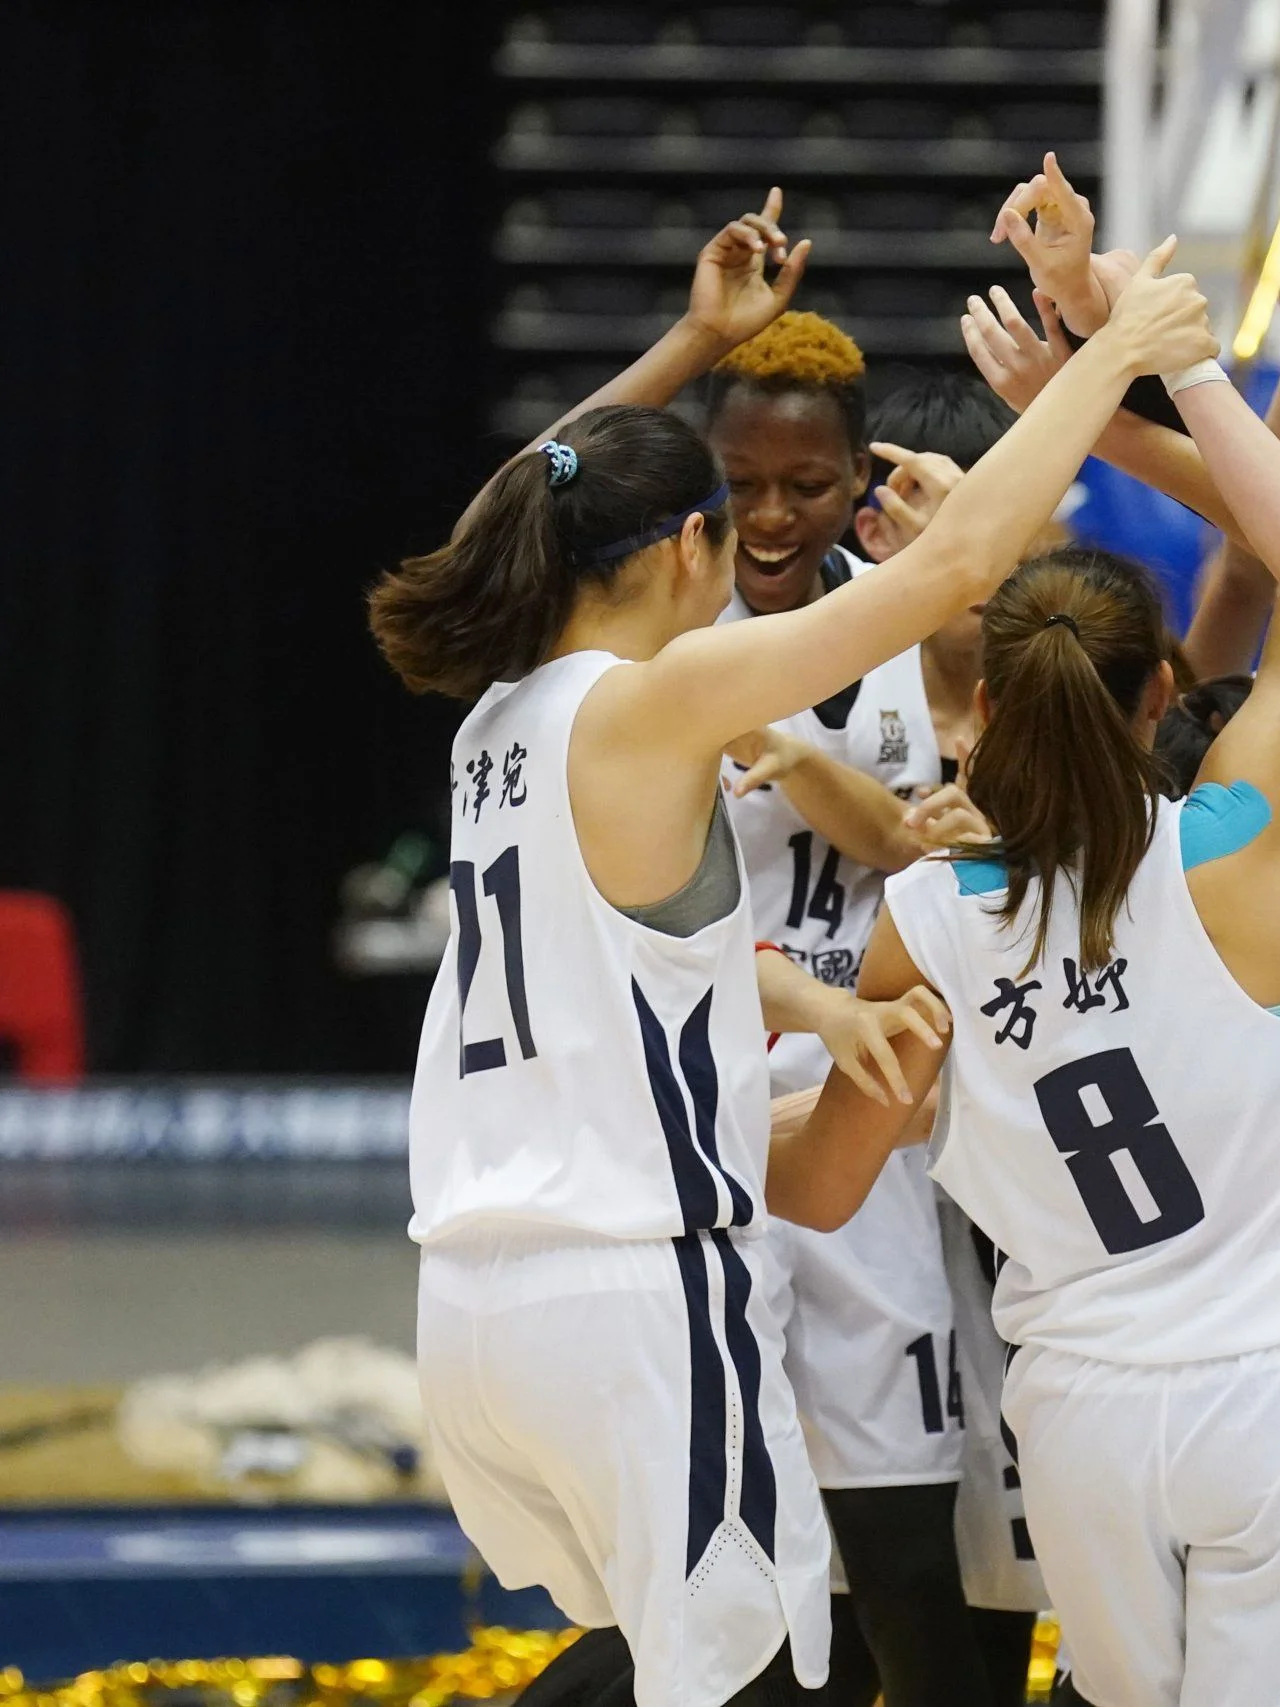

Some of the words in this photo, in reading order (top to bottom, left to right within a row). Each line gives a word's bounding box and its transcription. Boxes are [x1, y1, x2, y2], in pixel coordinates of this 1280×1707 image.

[450, 845, 539, 1080] 21
[785, 830, 845, 940] 14
[1033, 1046, 1205, 1255] 8
[905, 1330, 965, 1434] 14
